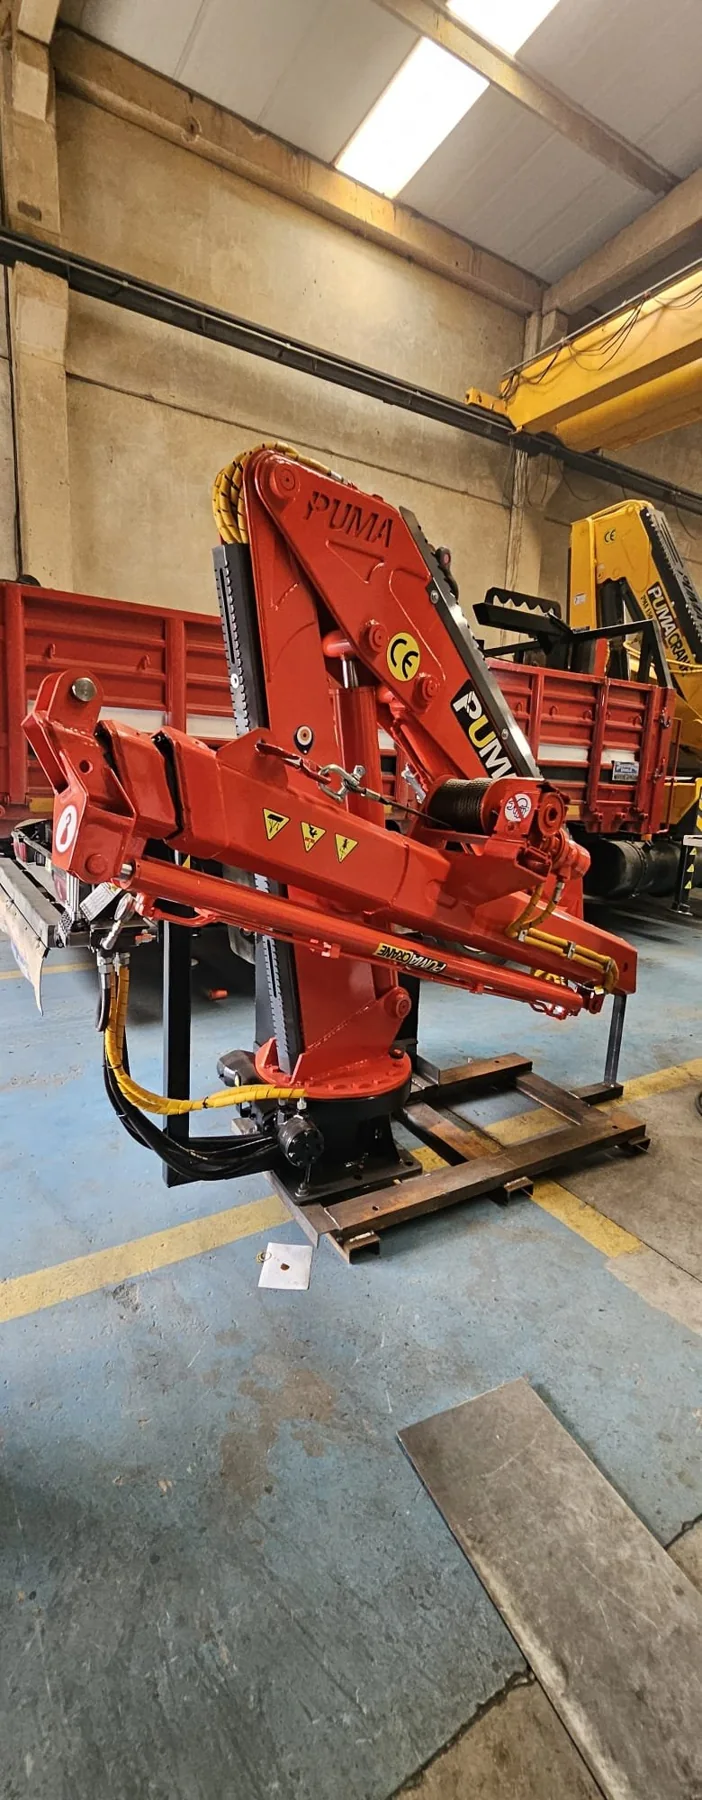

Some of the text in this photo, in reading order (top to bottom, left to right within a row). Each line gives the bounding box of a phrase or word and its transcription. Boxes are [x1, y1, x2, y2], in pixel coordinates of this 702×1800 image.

[303, 490, 393, 548] PUMA
[390, 638, 418, 679] CE
[452, 690, 518, 779] PUM
